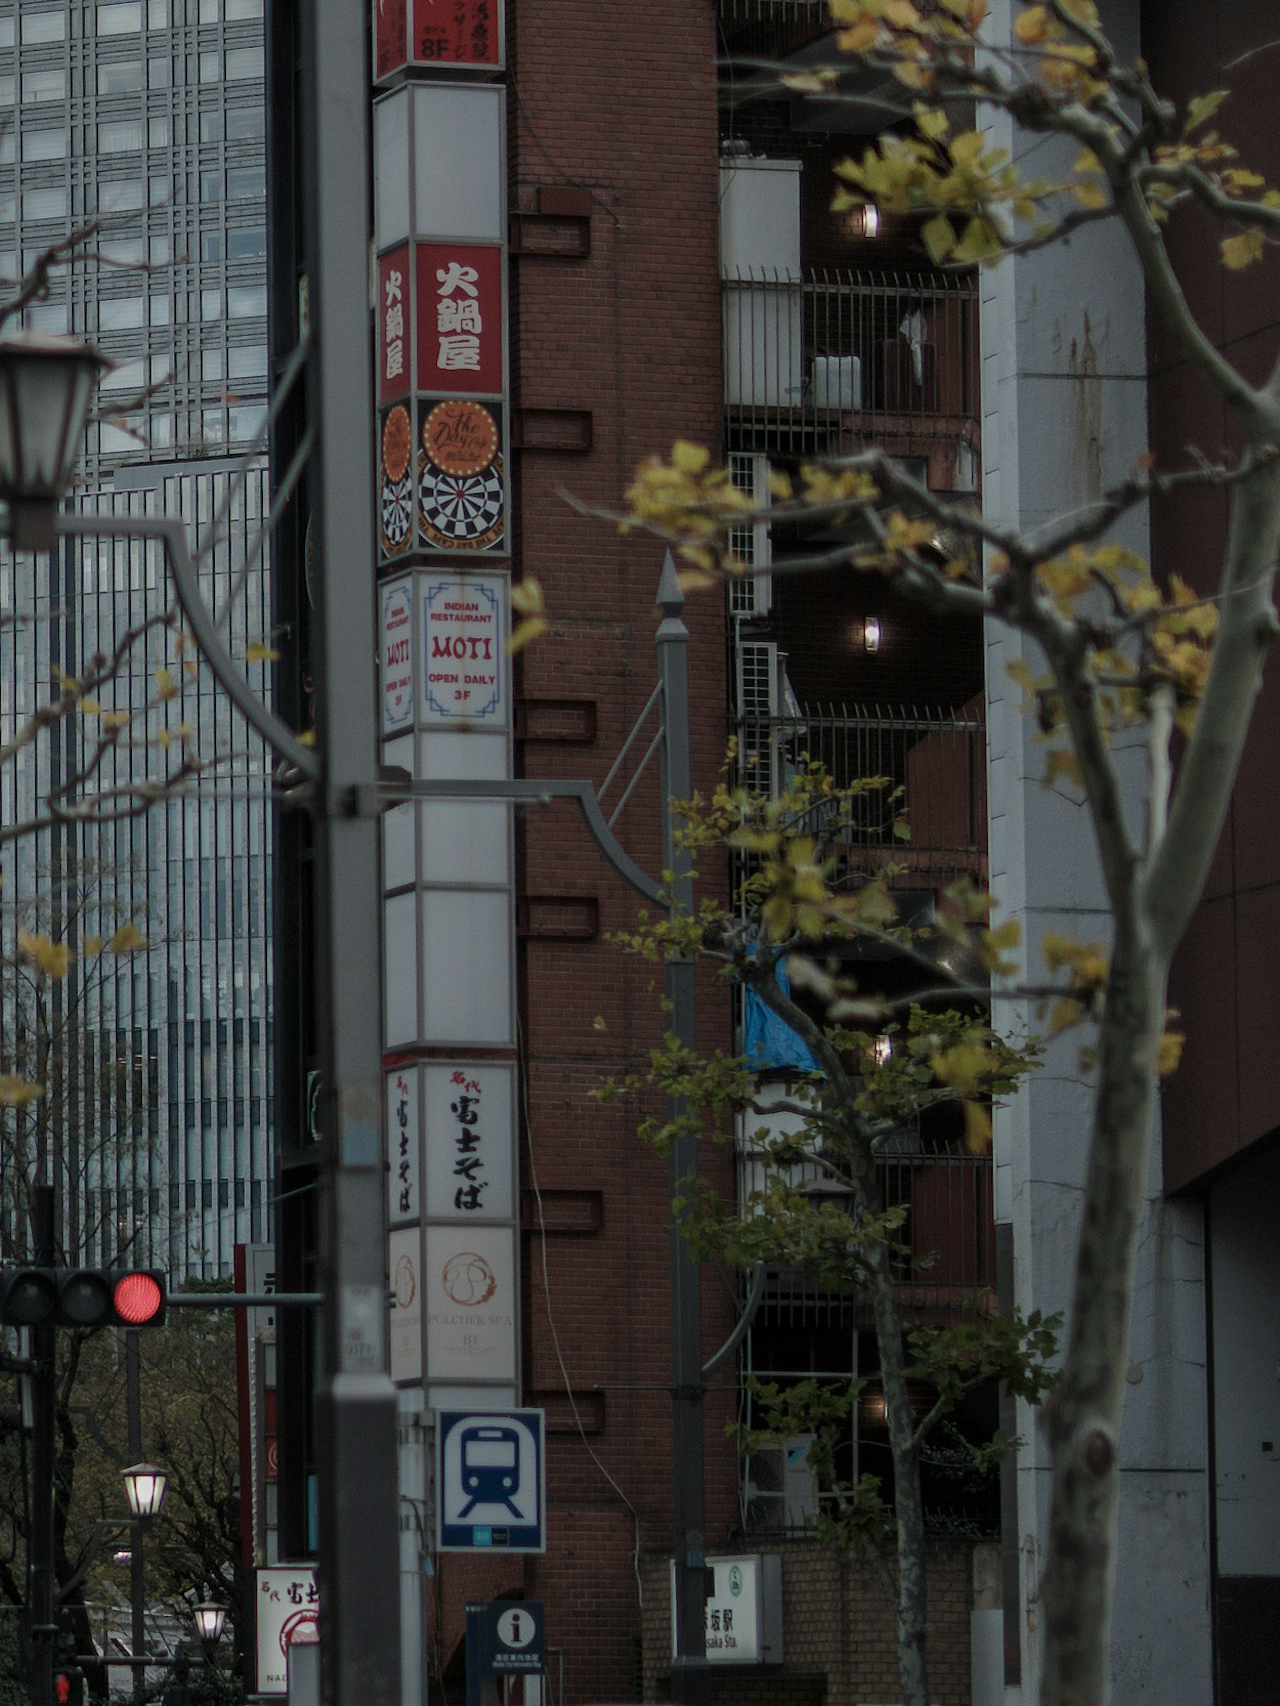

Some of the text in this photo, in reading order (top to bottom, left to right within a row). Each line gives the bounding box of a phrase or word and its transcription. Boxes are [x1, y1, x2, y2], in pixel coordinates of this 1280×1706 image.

[420, 38, 450, 58] 8F
[385, 270, 403, 379] 火鍋屋
[436, 261, 482, 371] 火鍋屋
[444, 602, 479, 611] INDIAN
[430, 613, 493, 623] RESTAURANT
[387, 639, 409, 667] MOTI
[431, 636, 493, 661] MOTI
[428, 673, 496, 685] OPEN DAILY
[454, 690, 471, 701] 3F
[451, 1096, 488, 1210] 富士そば
[488, 1314, 513, 1326] SPA
